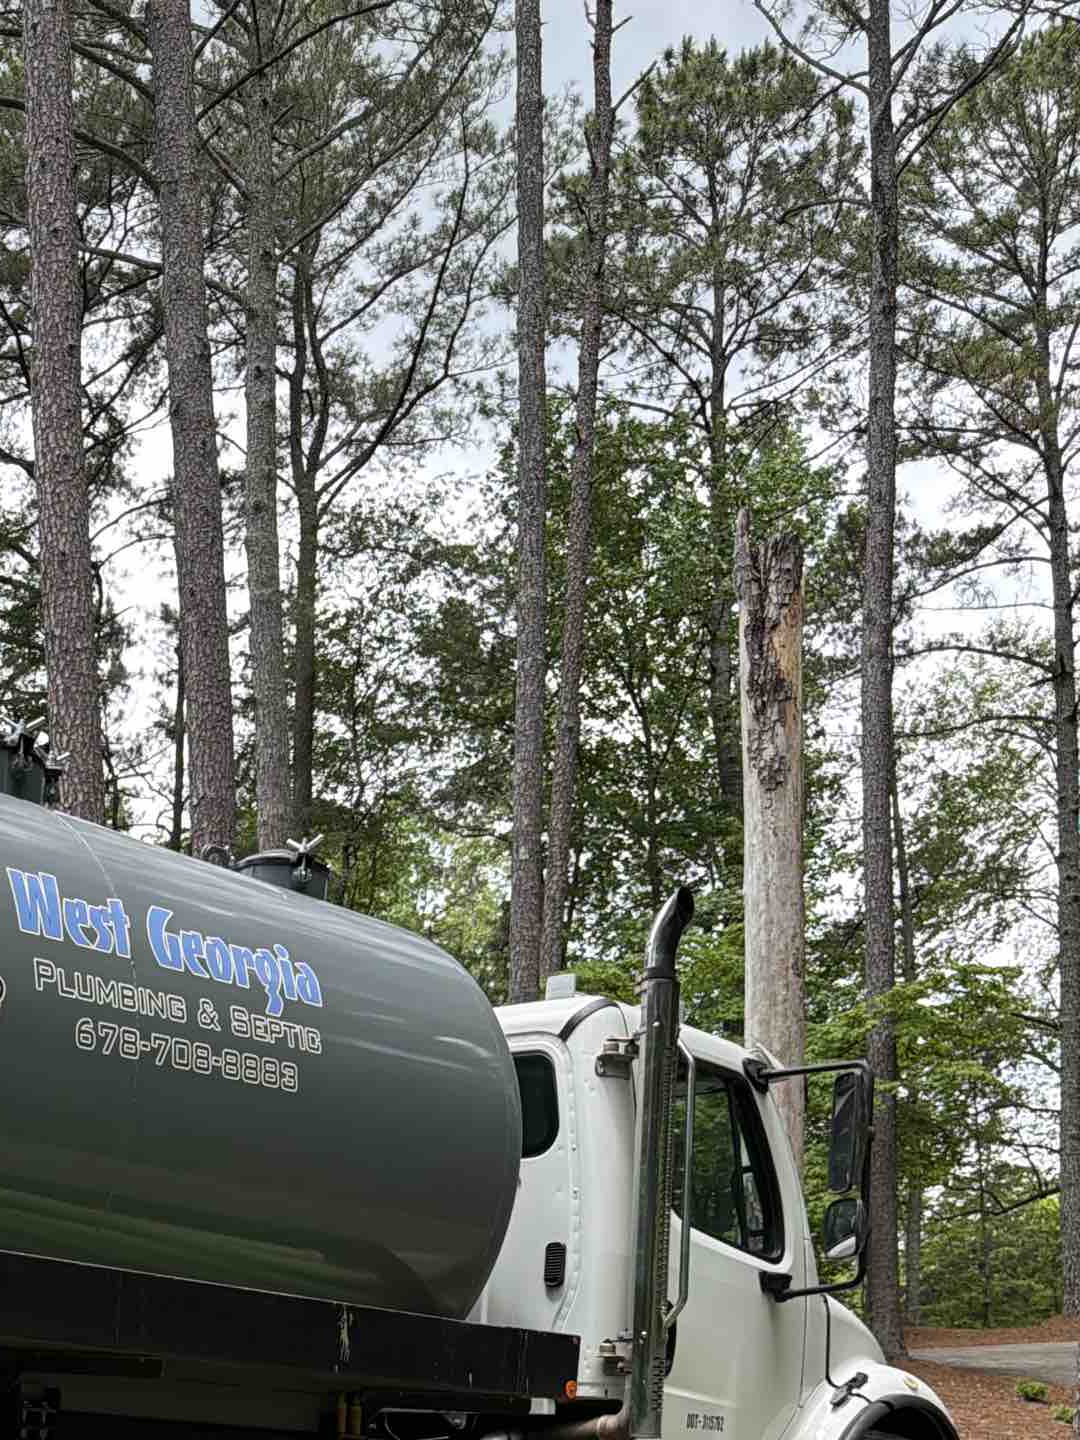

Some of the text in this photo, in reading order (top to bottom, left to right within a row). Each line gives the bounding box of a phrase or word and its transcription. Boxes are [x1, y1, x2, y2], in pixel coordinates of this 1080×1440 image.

[6, 867, 323, 1016] West Georgia
[33, 957, 321, 1054] PLUMBING & SEPTIC
[75, 1018, 298, 1092] 678-708-8883
